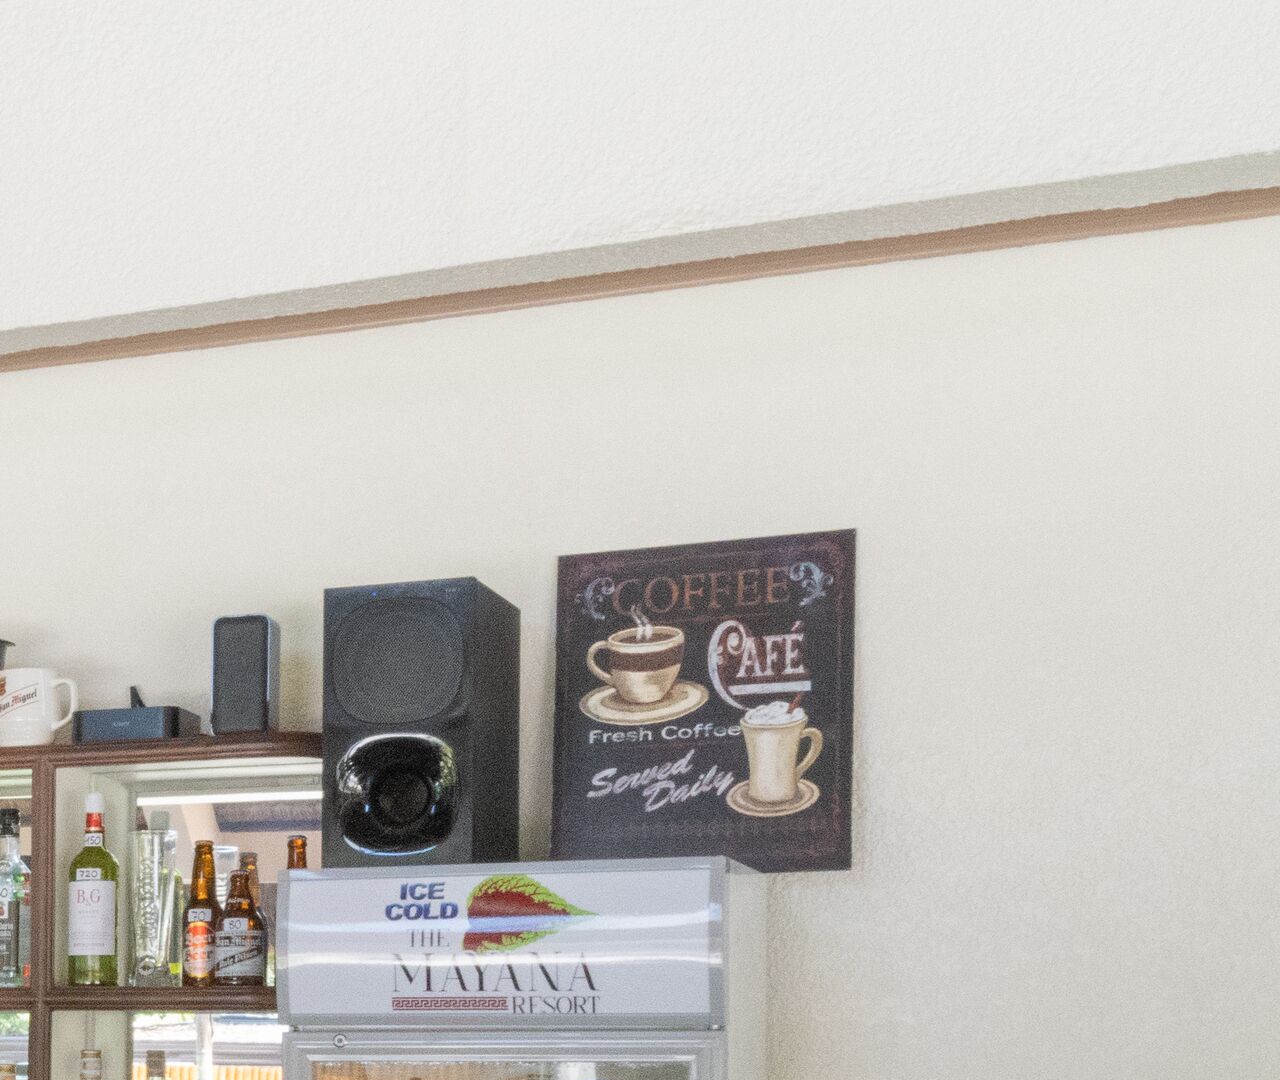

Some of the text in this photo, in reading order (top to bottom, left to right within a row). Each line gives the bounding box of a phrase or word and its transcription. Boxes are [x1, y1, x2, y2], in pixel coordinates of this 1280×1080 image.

[612, 566, 790, 616] COFFEE
[707, 620, 804, 710] CAFÉ
[589, 721, 741, 744] Fresh Coffee
[587, 750, 694, 798] Served
[643, 765, 734, 812] Daily
[79, 870, 97, 878] 720
[400, 882, 445, 900] ICE
[386, 901, 458, 921] COLD
[408, 929, 450, 947] THE
[392, 951, 598, 993] MAYANA
[512, 996, 600, 1015] RESORT
